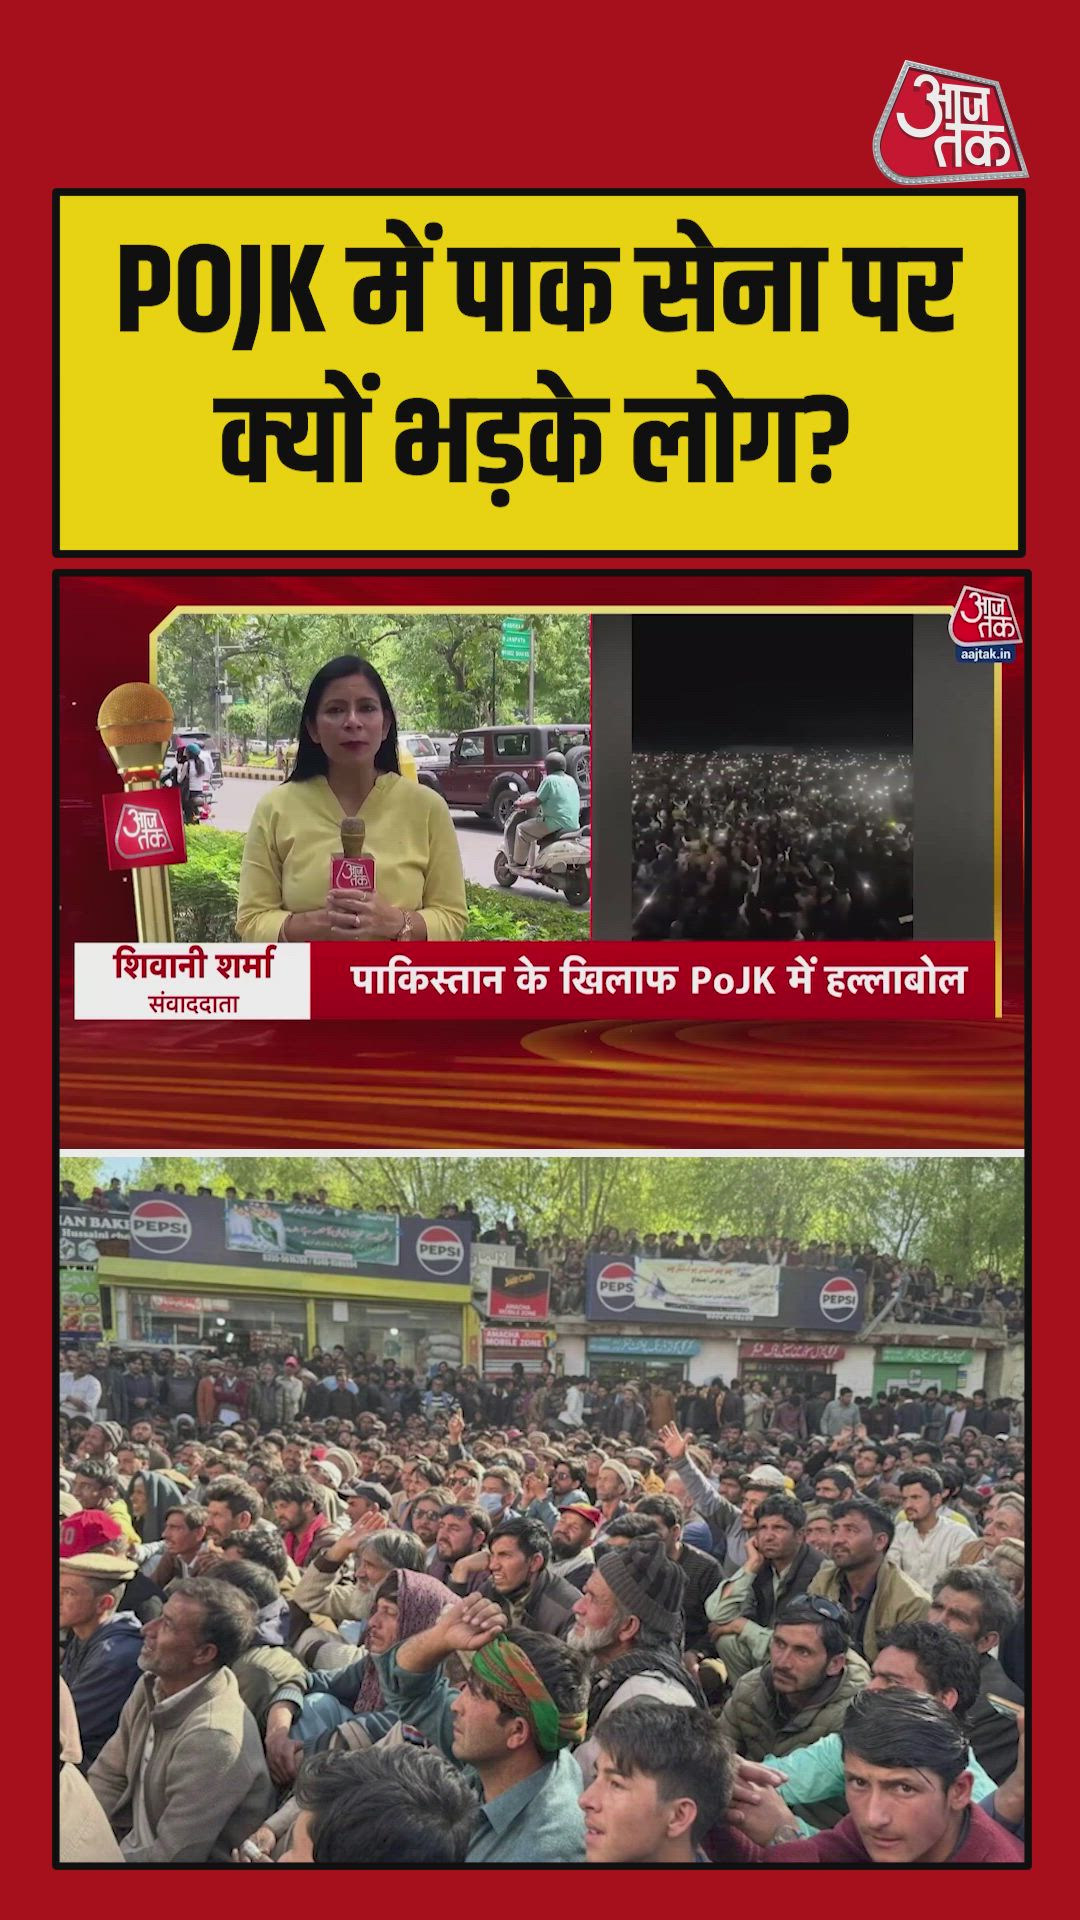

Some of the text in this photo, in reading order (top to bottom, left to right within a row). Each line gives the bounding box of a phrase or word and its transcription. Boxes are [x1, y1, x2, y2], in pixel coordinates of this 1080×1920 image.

[341, 863, 364, 879] आज
[350, 874, 368, 886] तक
[133, 1219, 188, 1235] PEPSI
[419, 1243, 461, 1257] PEPSI
[600, 1280, 634, 1293] PEPS
[822, 1294, 856, 1306] PEPSI
[486, 1330, 520, 1338] AMACHA
[485, 1338, 542, 1347] MOBILE ZONE
